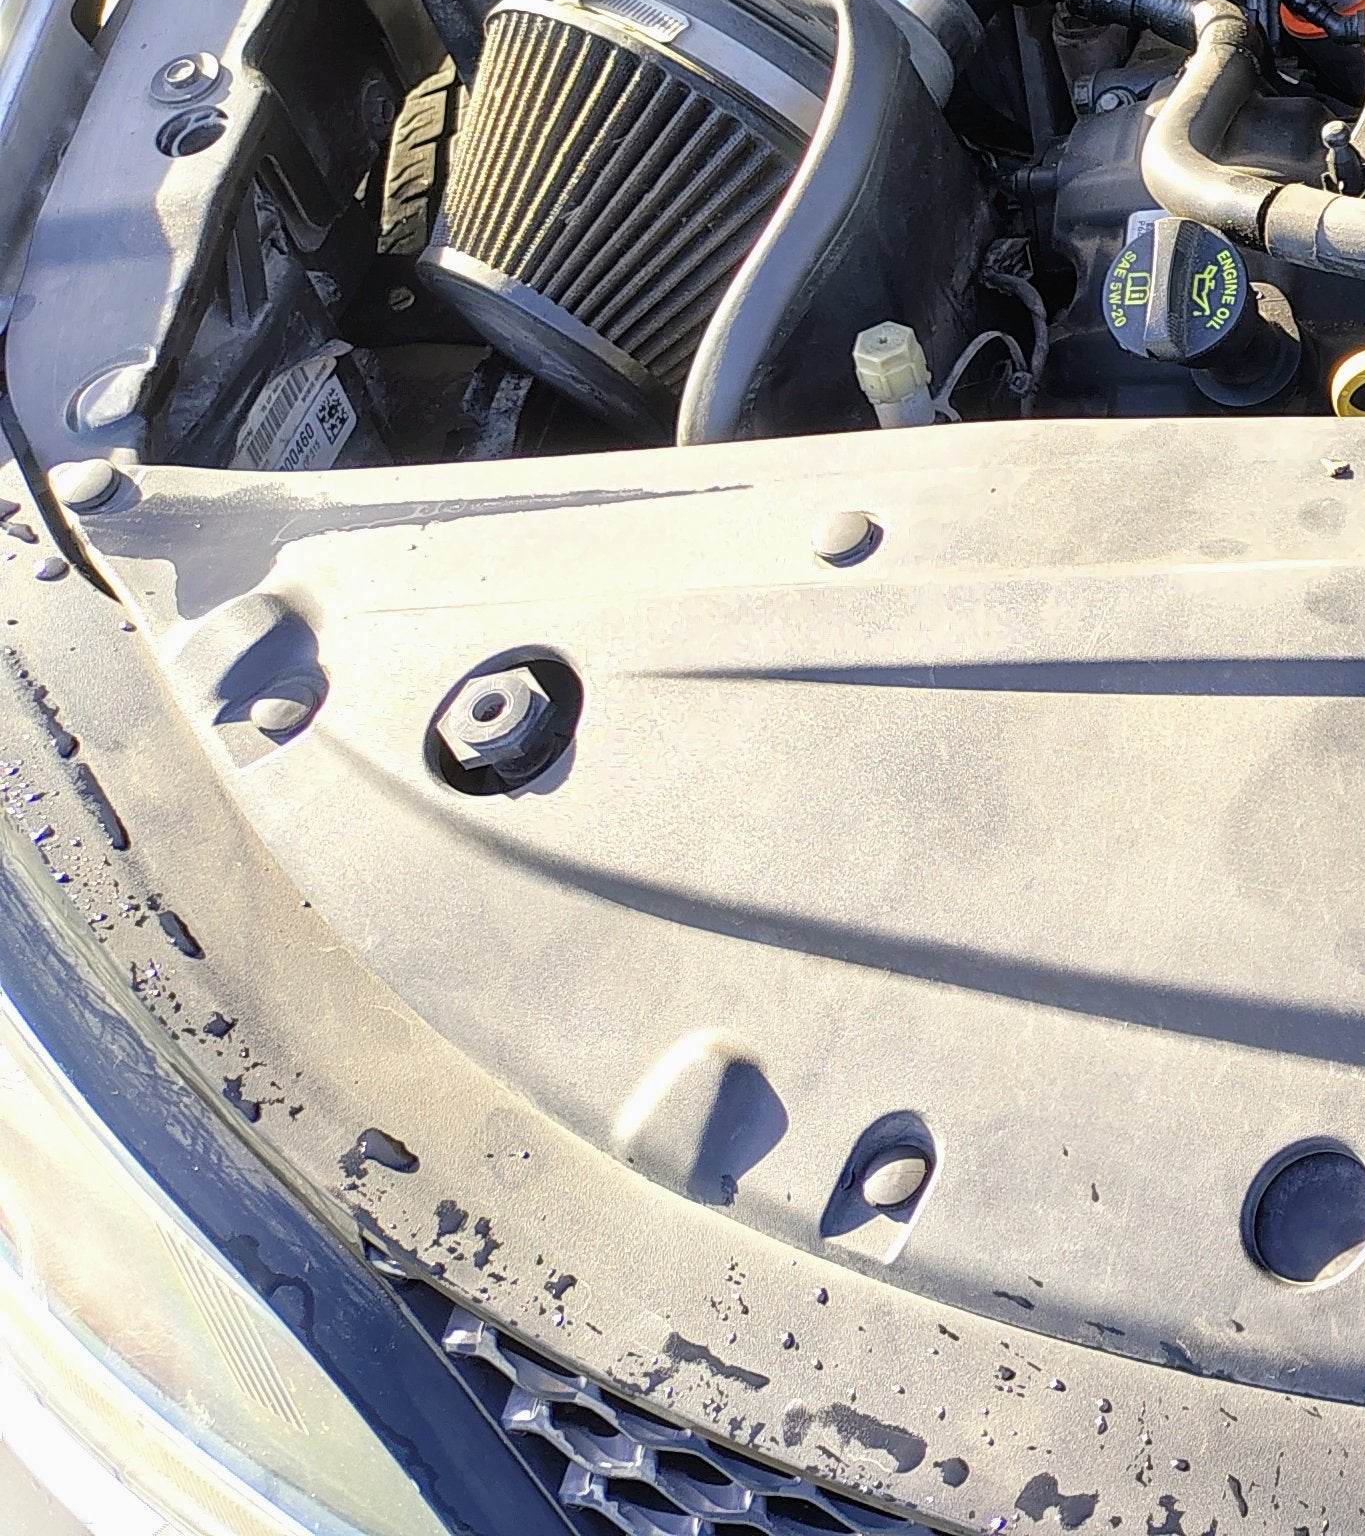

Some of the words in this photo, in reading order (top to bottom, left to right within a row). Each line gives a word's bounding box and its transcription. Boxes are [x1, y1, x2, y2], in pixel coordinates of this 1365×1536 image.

[1113, 250, 1138, 279] SAE
[1216, 249, 1239, 305] ENGINE
[1107, 282, 1128, 329] 5W-20
[1205, 307, 1231, 331] OIL
[279, 421, 315, 471] 00460
